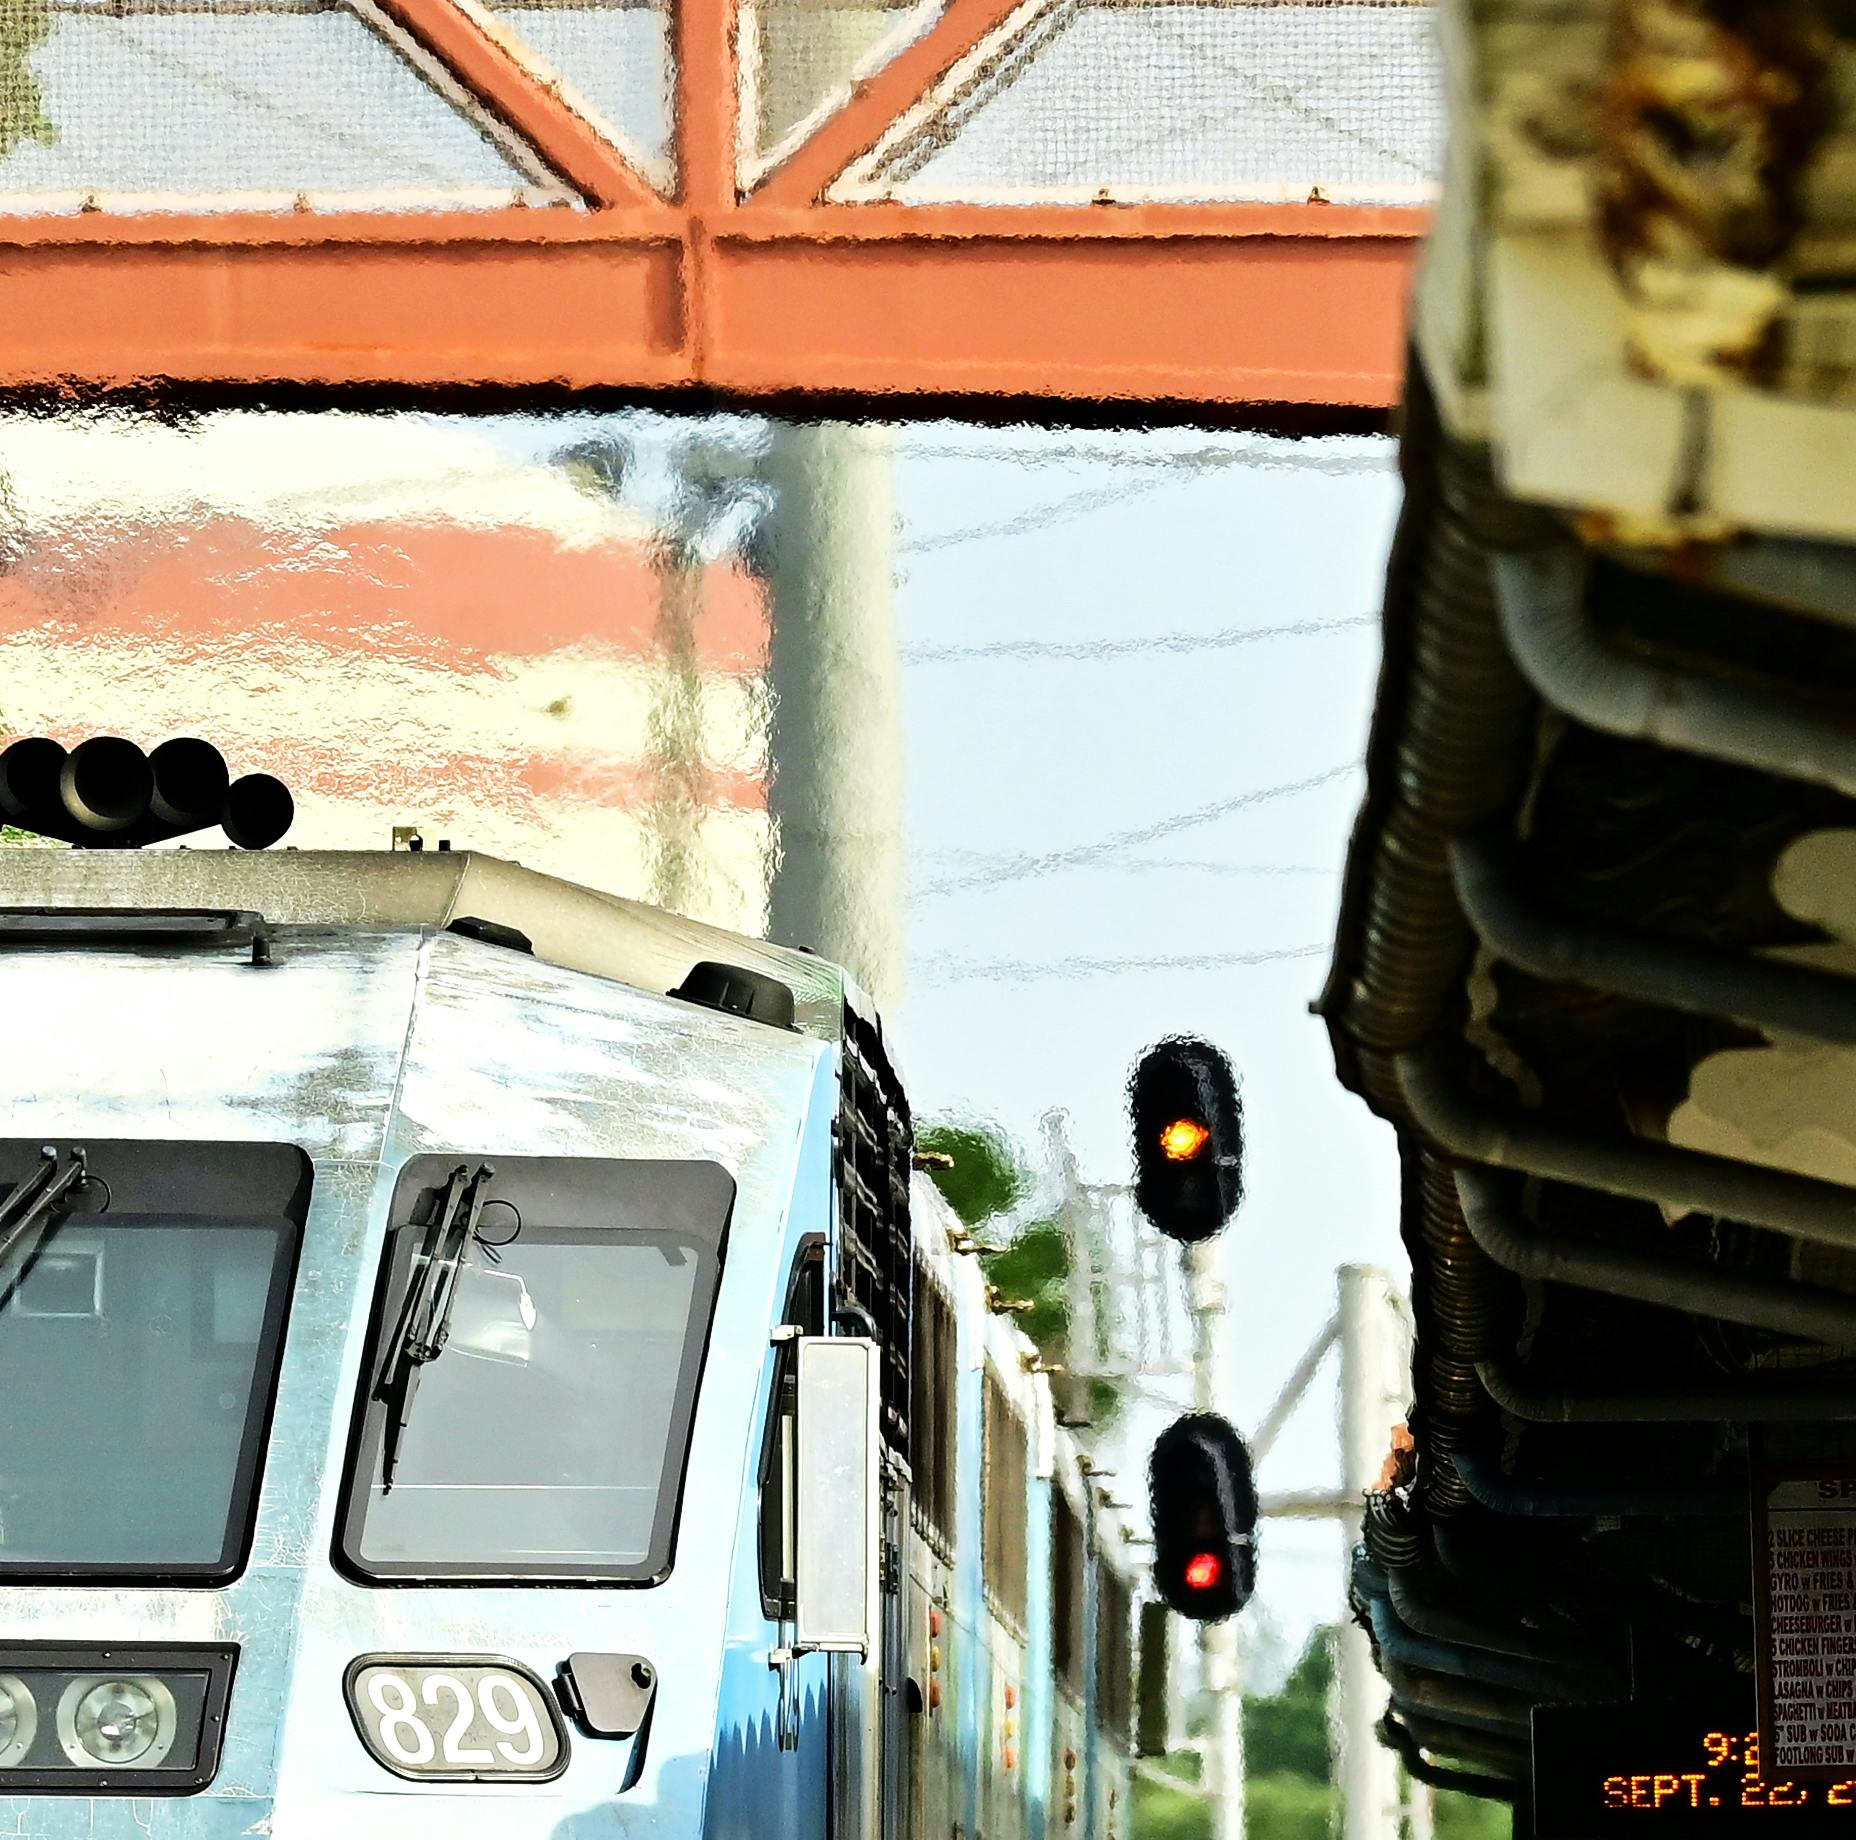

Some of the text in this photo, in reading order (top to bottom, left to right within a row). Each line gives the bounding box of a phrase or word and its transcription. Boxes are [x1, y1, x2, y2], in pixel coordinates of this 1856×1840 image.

[1768, 1529, 1774, 1548] 2
[1777, 1529, 1805, 1548] SLICE
[1807, 1528, 1844, 1547] CHEESE
[1777, 1550, 1819, 1568] CHICKEN
[1820, 1549, 1852, 1568] WINGS
[1770, 1572, 1798, 1591] GYRO
[1813, 1572, 1843, 1589] FRIES
[1823, 1593, 1851, 1611] FRIES
[1770, 1615, 1842, 1634] CHEESEBURGER
[1779, 1636, 1819, 1655] CHICKEN
[1771, 1658, 1824, 1677] STROMBOLI
[1826, 1679, 1853, 1697] CHIPS
[367, 1673, 544, 1764] 829
[1787, 1725, 1807, 1742] SUB
[1821, 1724, 1847, 1741] SODA
[1825, 1746, 1844, 1763] SUB
[1603, 1774, 1720, 1807] SEPT.
